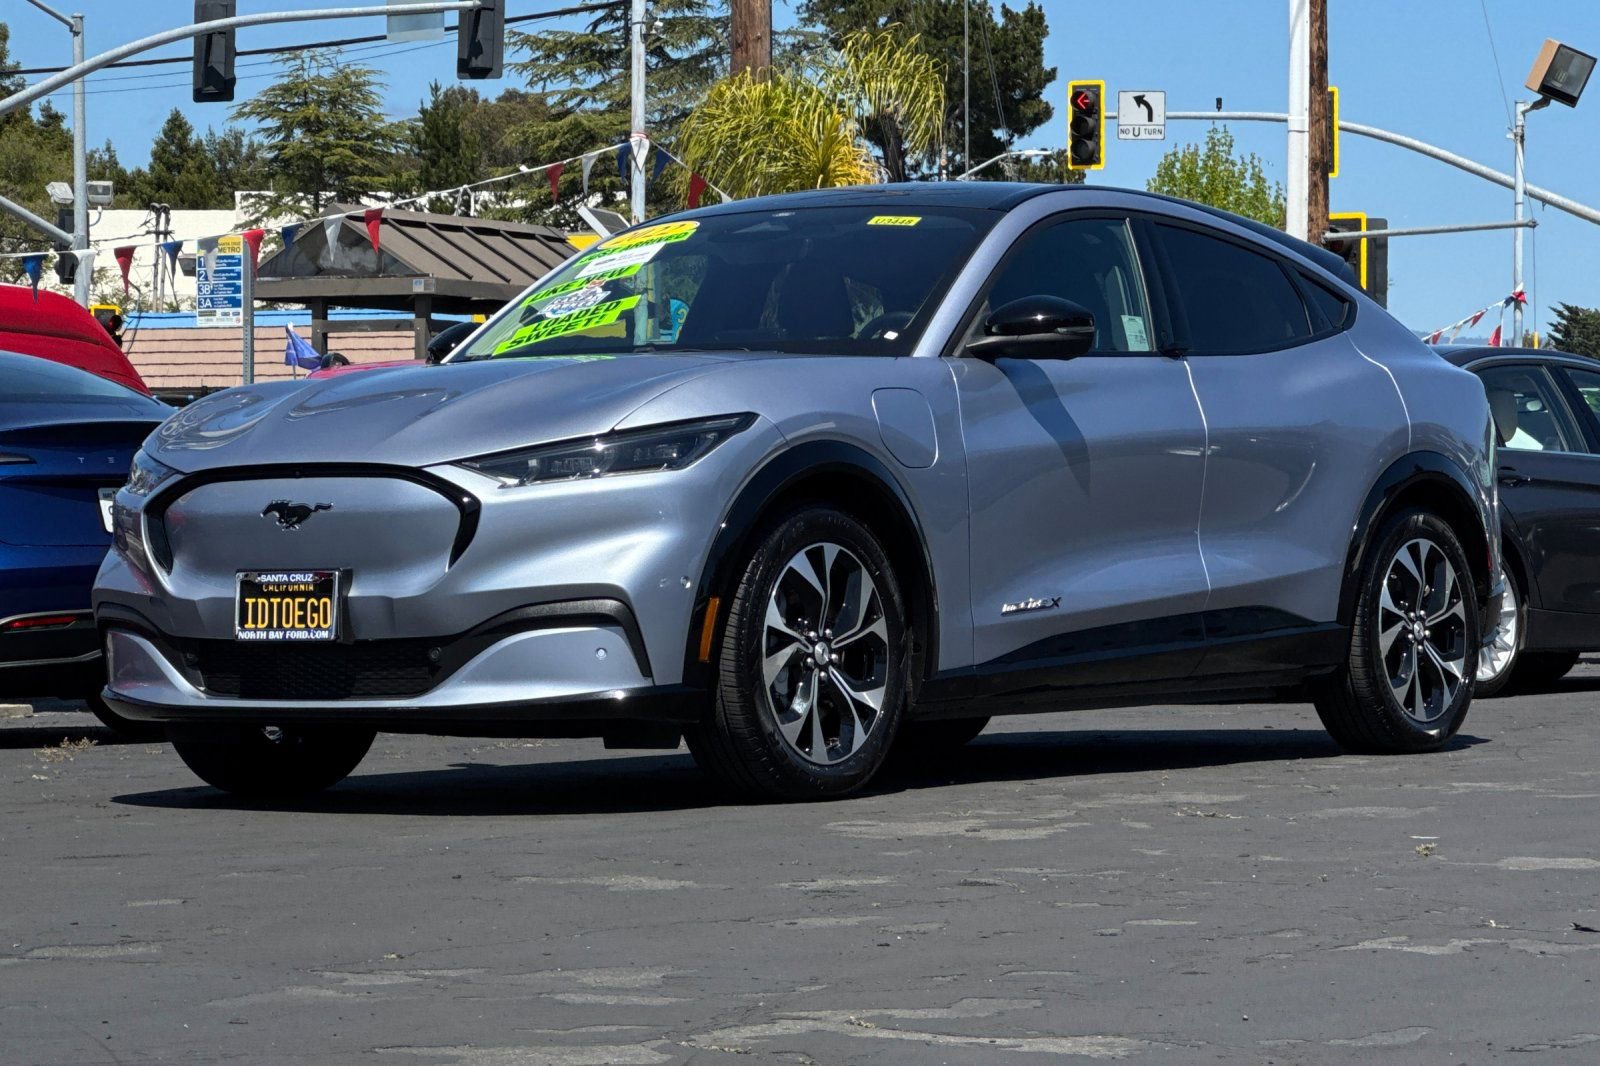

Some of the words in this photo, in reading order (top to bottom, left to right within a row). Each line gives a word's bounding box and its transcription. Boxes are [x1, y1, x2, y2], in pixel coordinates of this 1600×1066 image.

[1132, 127, 1140, 137] U
[200, 257, 205, 267] 1
[199, 271, 206, 281] 2
[198, 284, 211, 295] 3B
[530, 281, 573, 303] LIKE
[580, 266, 632, 287] NEW
[198, 298, 213, 309] 3A
[532, 301, 621, 332] LOADED
[506, 314, 605, 349] SWEET!
[261, 574, 288, 582] SANTA
[290, 573, 314, 582] CRUZ
[262, 583, 314, 592] CALIFORNIA
[244, 597, 330, 628] IDTOEGO
[238, 631, 266, 640] NORTH
[268, 631, 285, 639] BAY
[286, 630, 329, 639] FORD.COM
